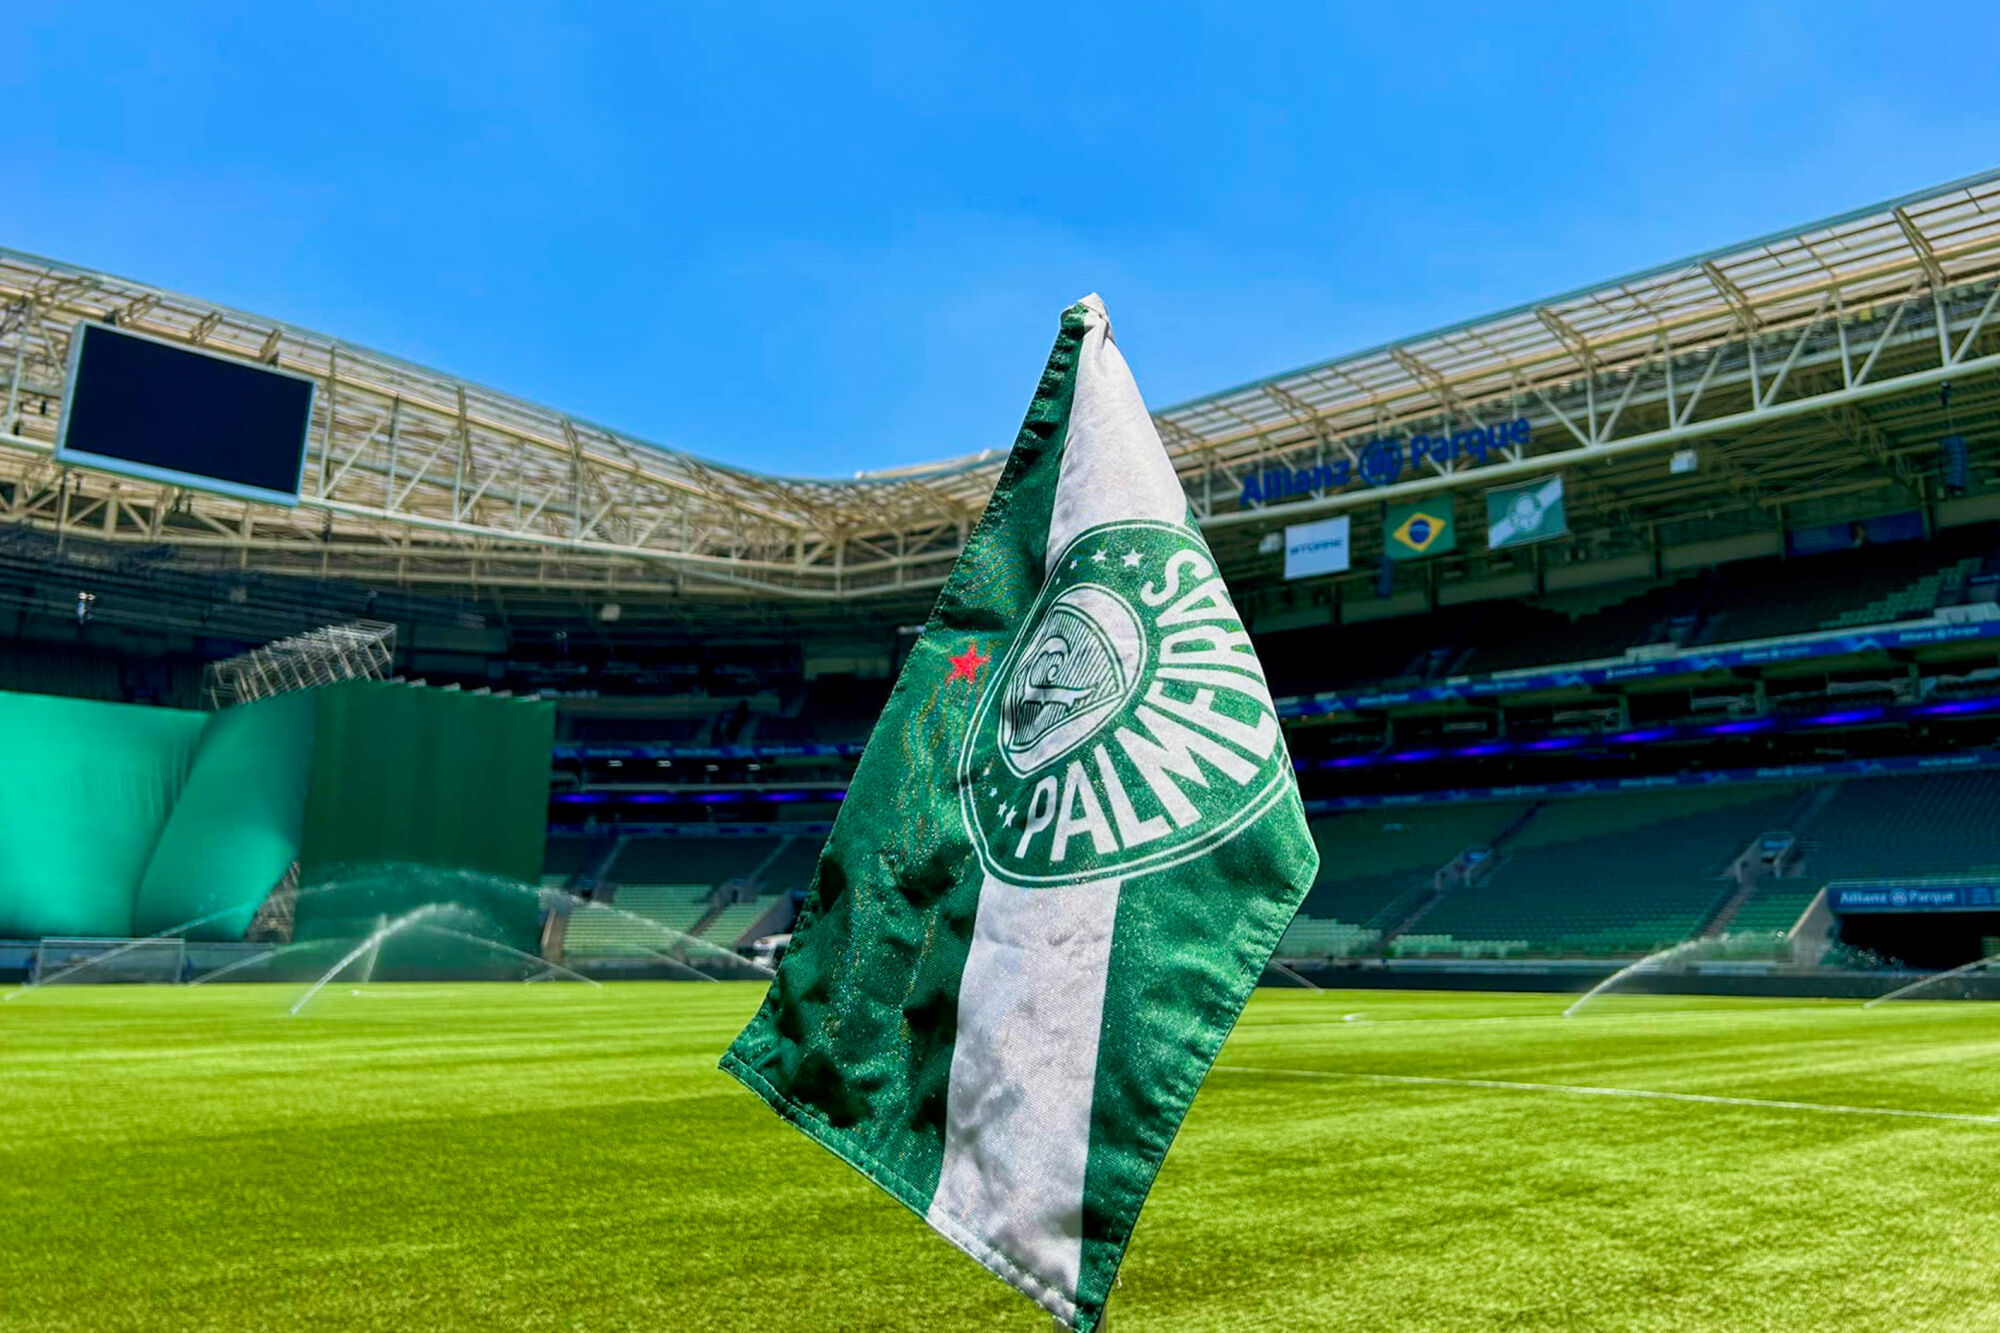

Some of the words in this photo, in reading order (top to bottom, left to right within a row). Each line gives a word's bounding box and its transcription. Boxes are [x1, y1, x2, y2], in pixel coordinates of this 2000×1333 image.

[1239, 459, 1351, 507] Allianz
[1410, 417, 1530, 469] Parque
[1014, 549, 1278, 861] PALMEIRAS
[1839, 890, 1888, 905] Allianz
[1908, 889, 1956, 906] Parque
